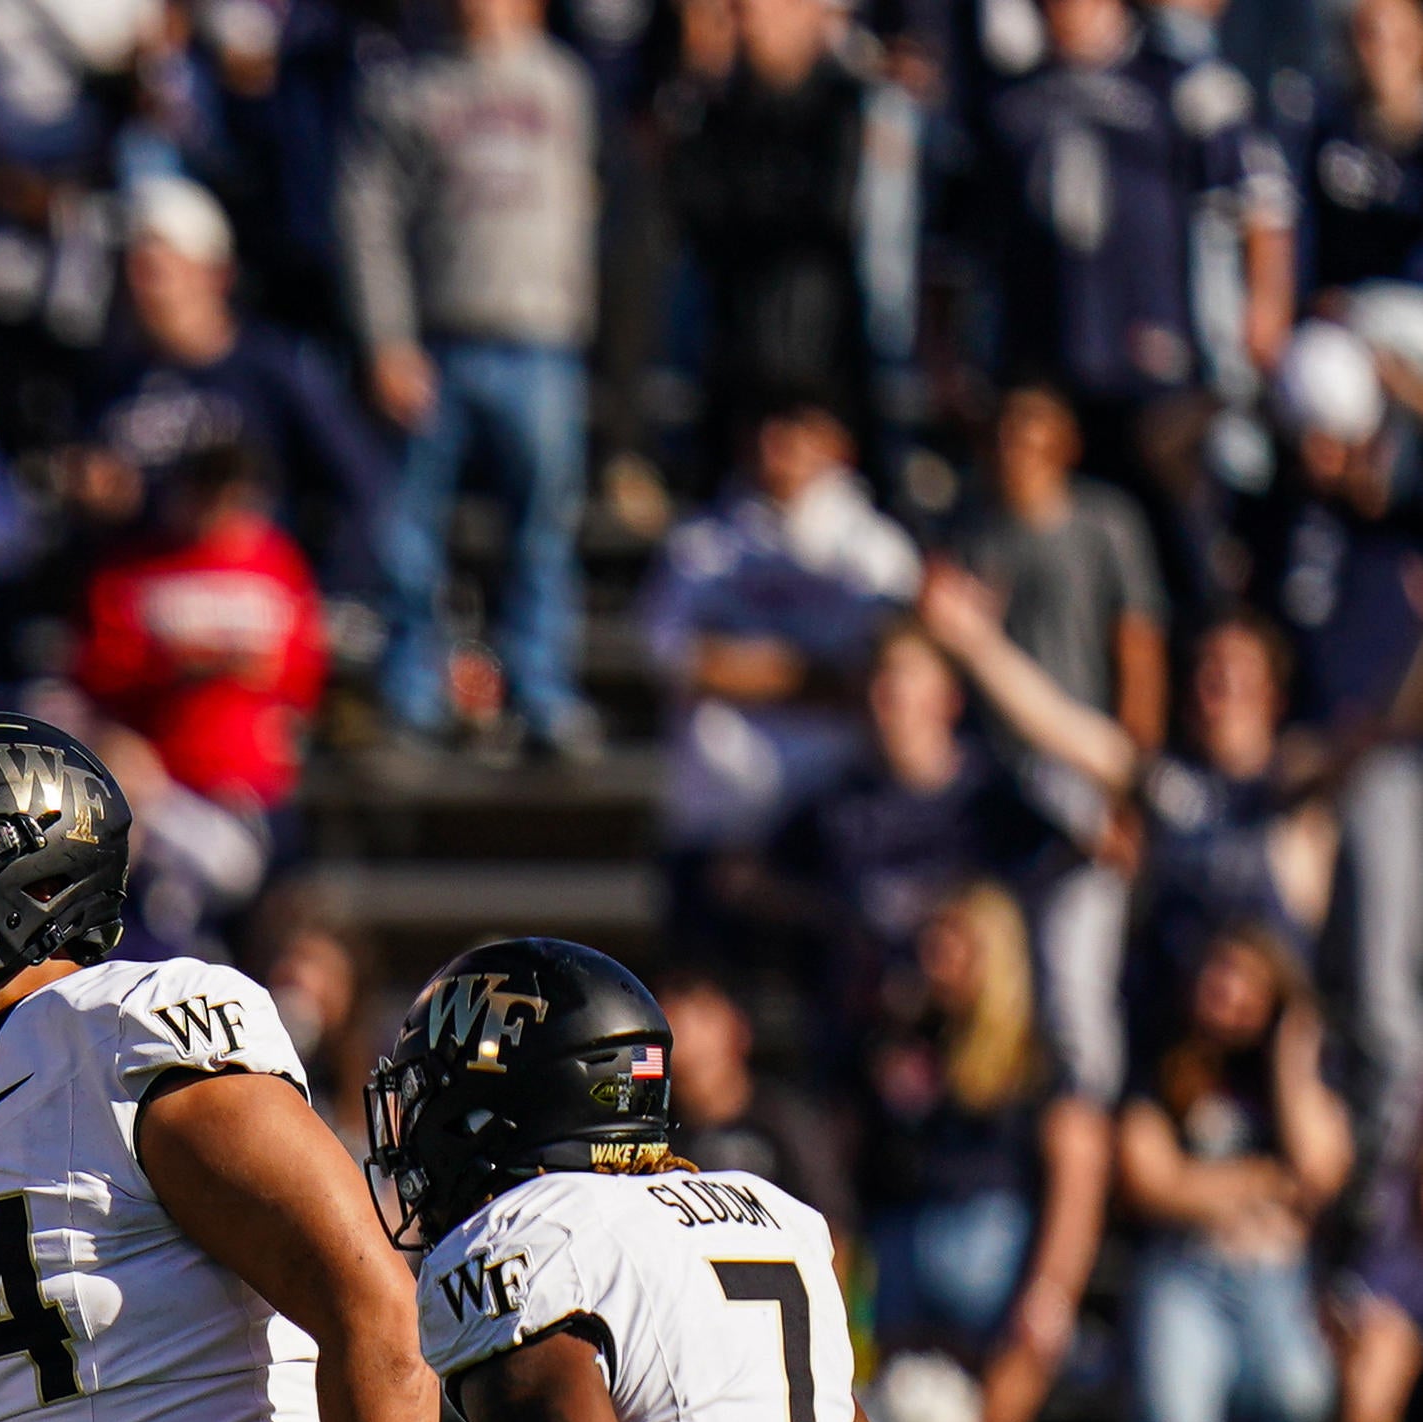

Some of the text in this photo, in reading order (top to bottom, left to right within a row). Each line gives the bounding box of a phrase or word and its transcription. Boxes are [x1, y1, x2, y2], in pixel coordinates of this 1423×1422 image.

[152, 994, 246, 1056] WF
[428, 972, 549, 1074] WF
[590, 1143, 635, 1164] WAKE
[646, 1179, 782, 1230] SLOCUM
[436, 1250, 530, 1325] WF
